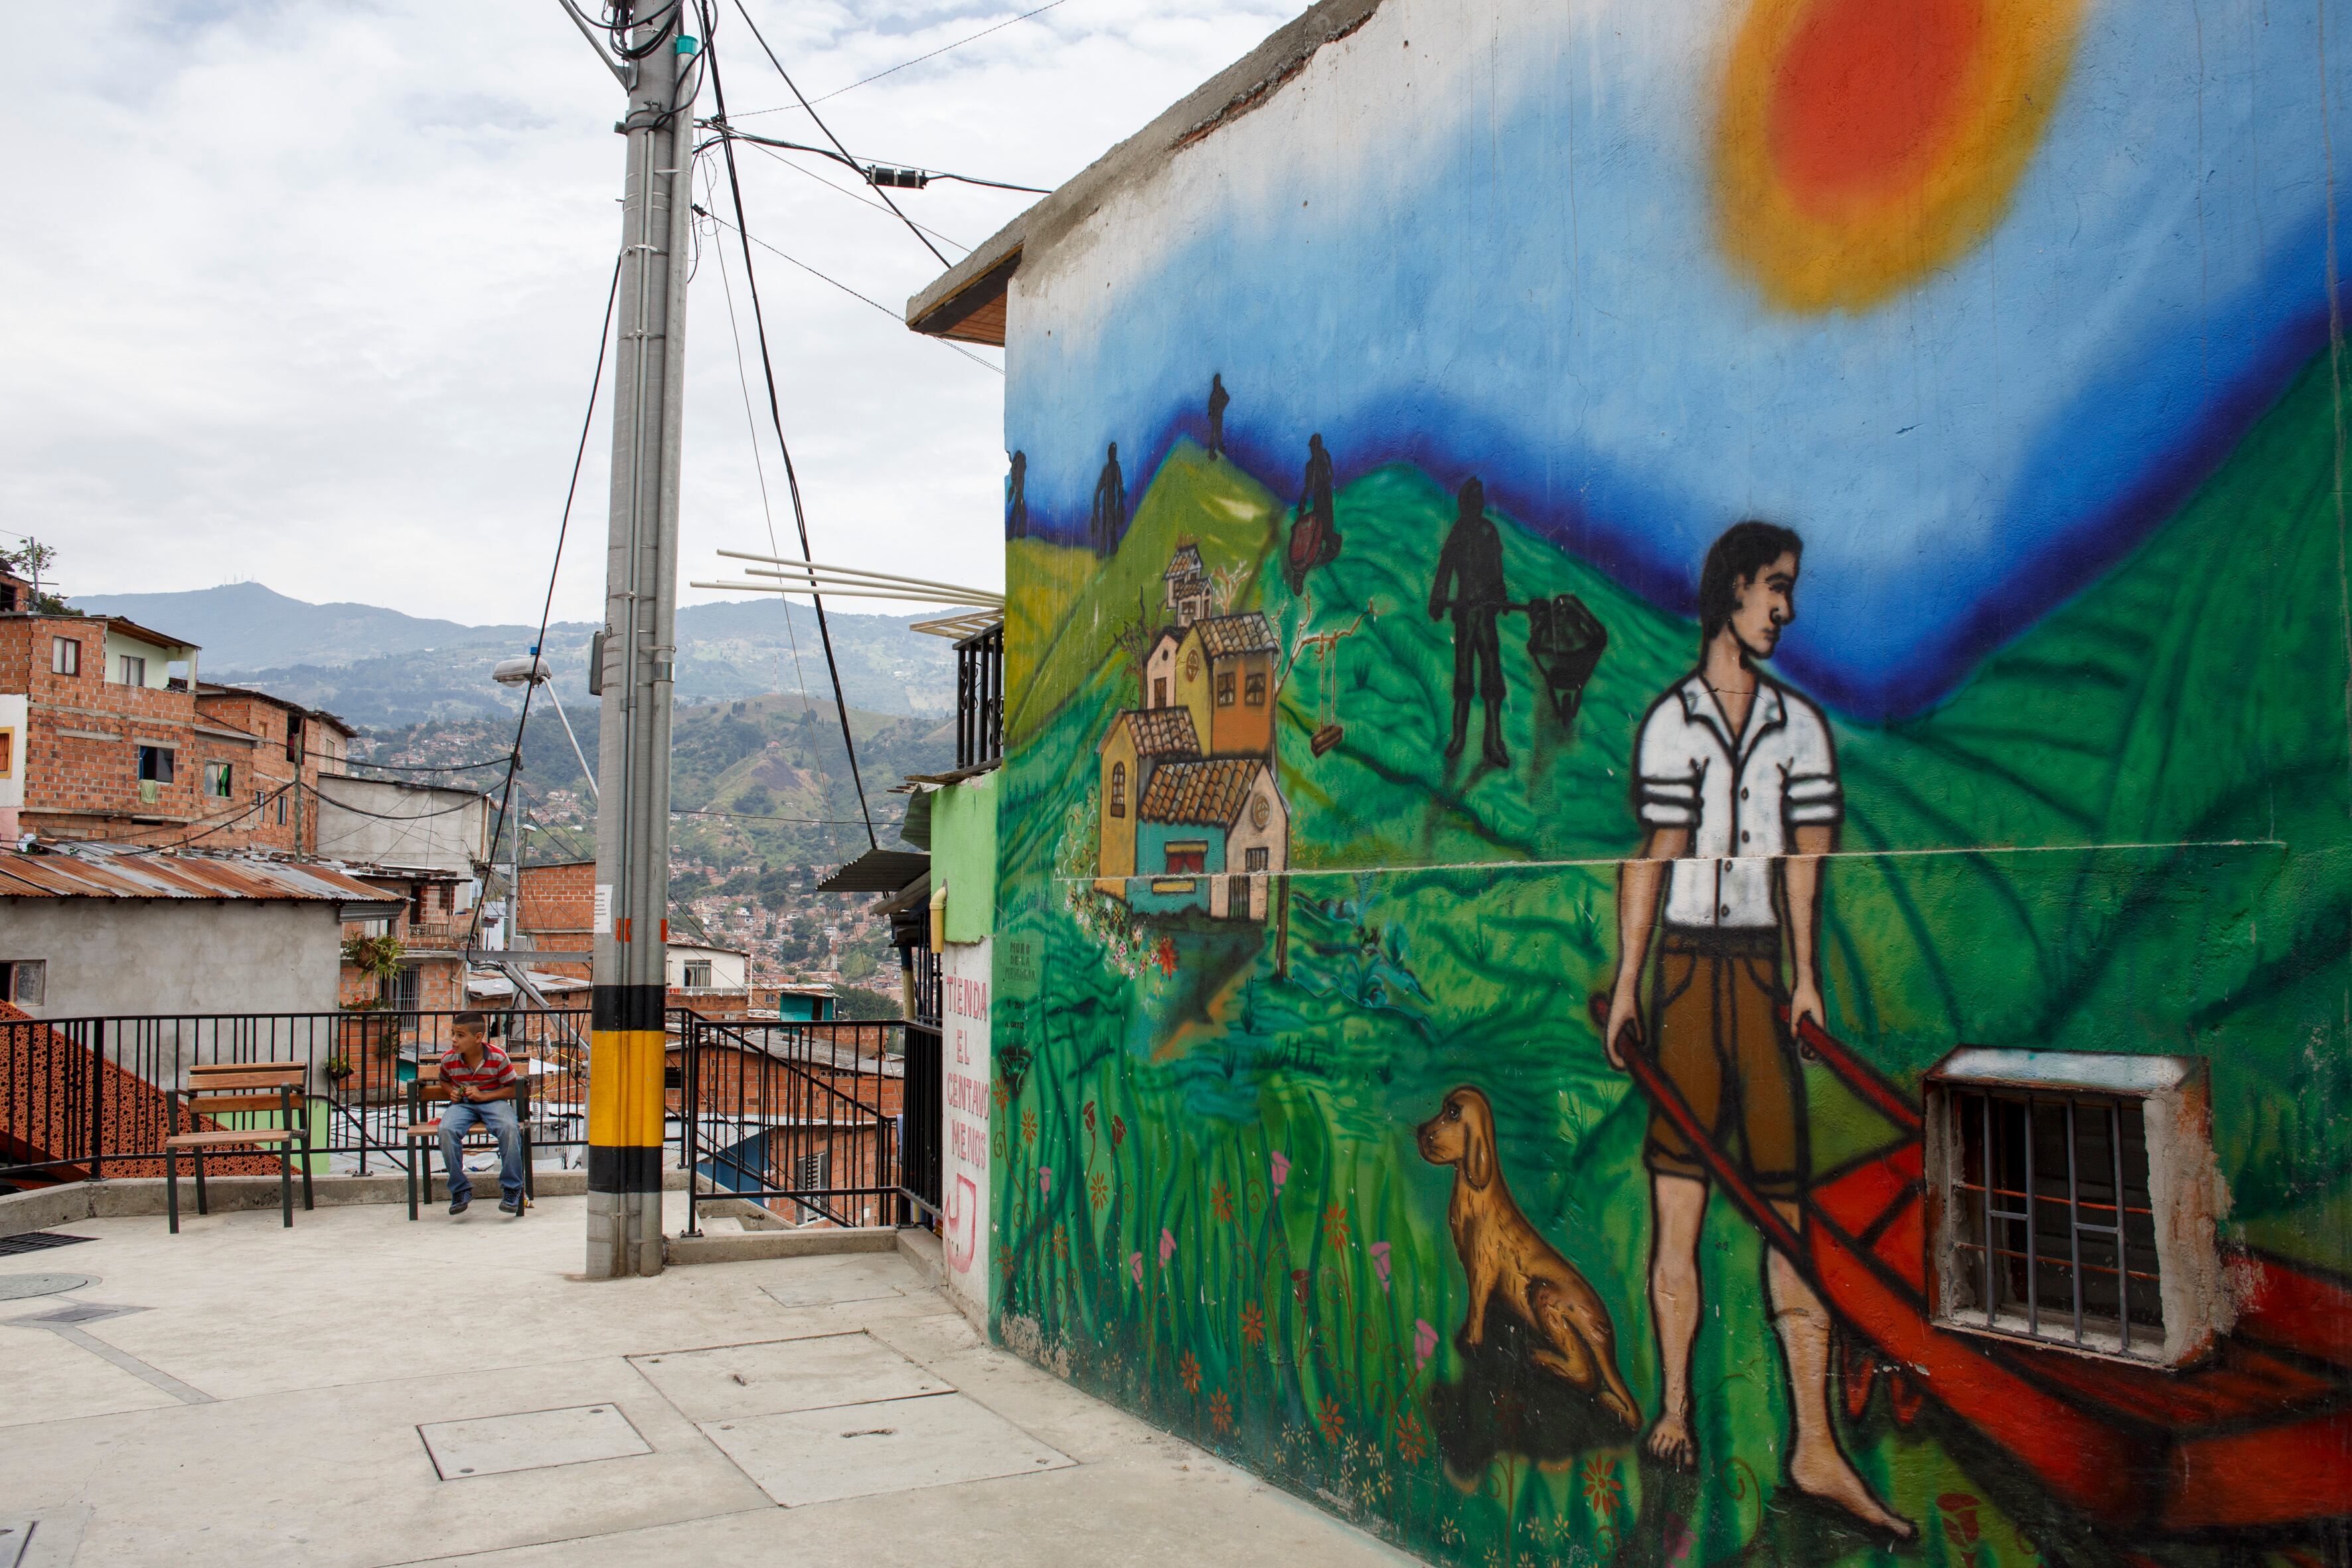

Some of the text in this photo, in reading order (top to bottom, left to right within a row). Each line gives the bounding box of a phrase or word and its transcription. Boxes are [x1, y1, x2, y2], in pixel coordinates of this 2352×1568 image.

[1010, 942, 1030, 955] MURO
[1010, 955, 1030, 967] DE LA
[957, 1029, 969, 1065] EL
[947, 1072, 990, 1120] CENTAVO
[951, 1119, 986, 1170] MENOS
